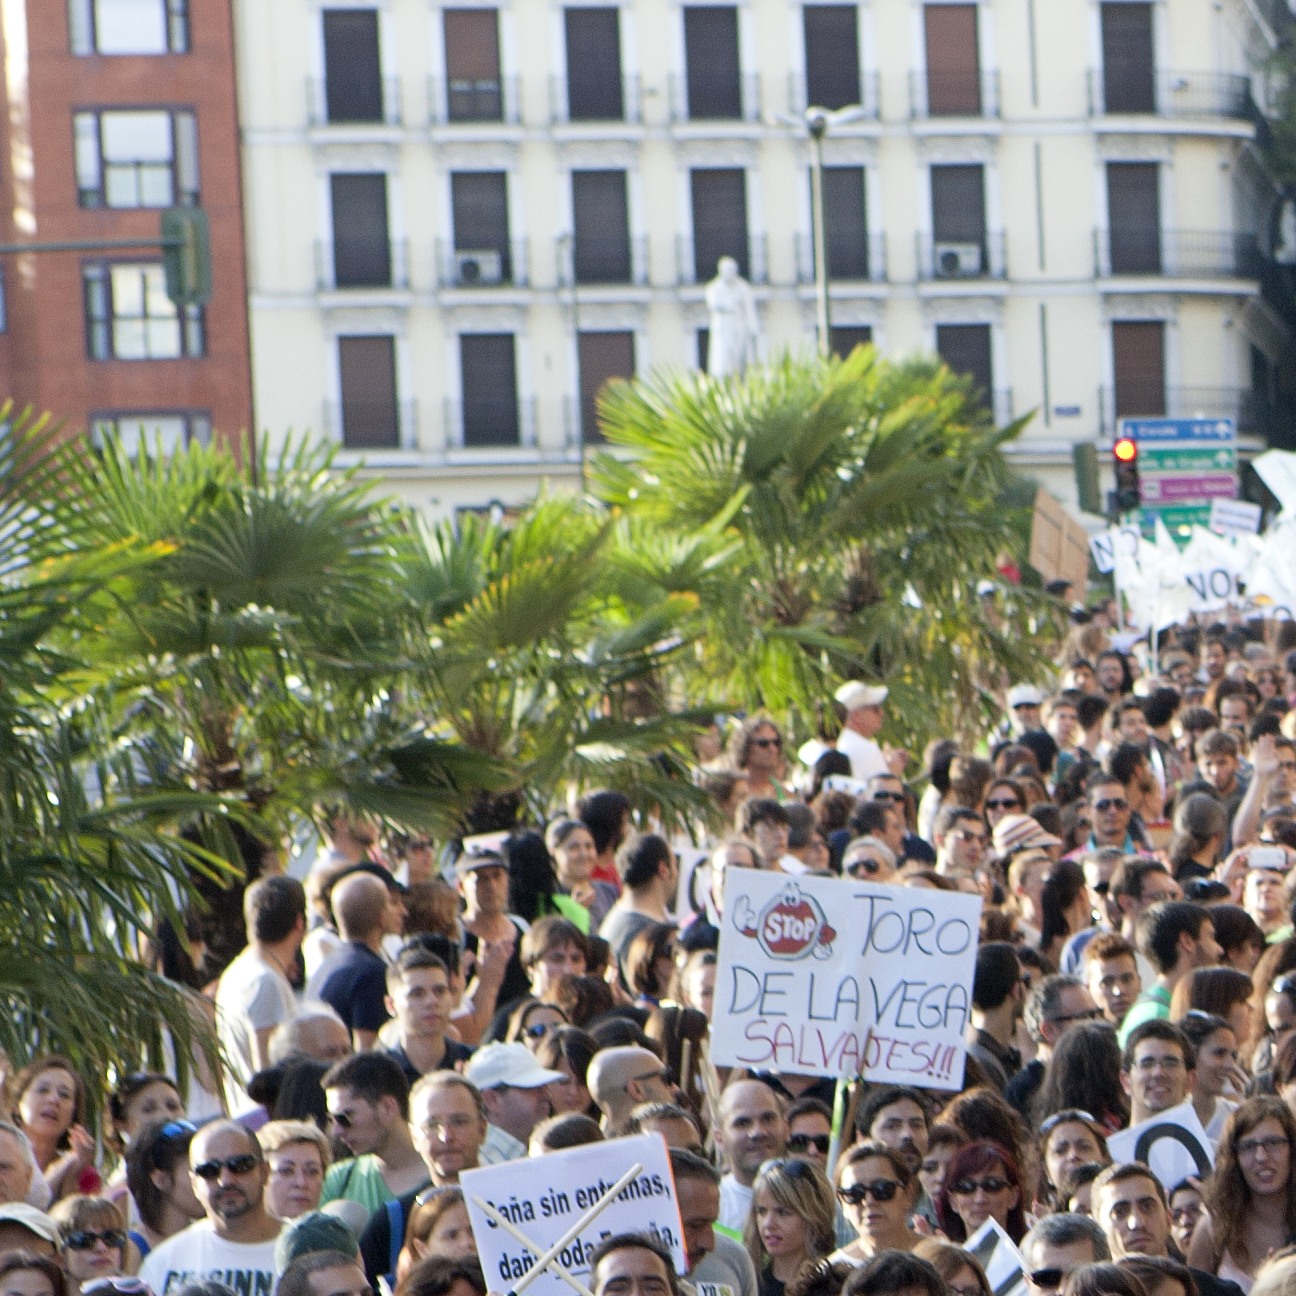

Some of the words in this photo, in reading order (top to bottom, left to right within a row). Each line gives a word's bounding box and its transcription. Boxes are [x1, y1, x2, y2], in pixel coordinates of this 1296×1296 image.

[1184, 569, 1232, 601] NO
[764, 914, 816, 943] STOP
[854, 894, 972, 957] TORO
[728, 965, 795, 1017] DE
[807, 973, 860, 1022] LA
[869, 977, 970, 1036] VEGA
[541, 1187, 571, 1218] sin
